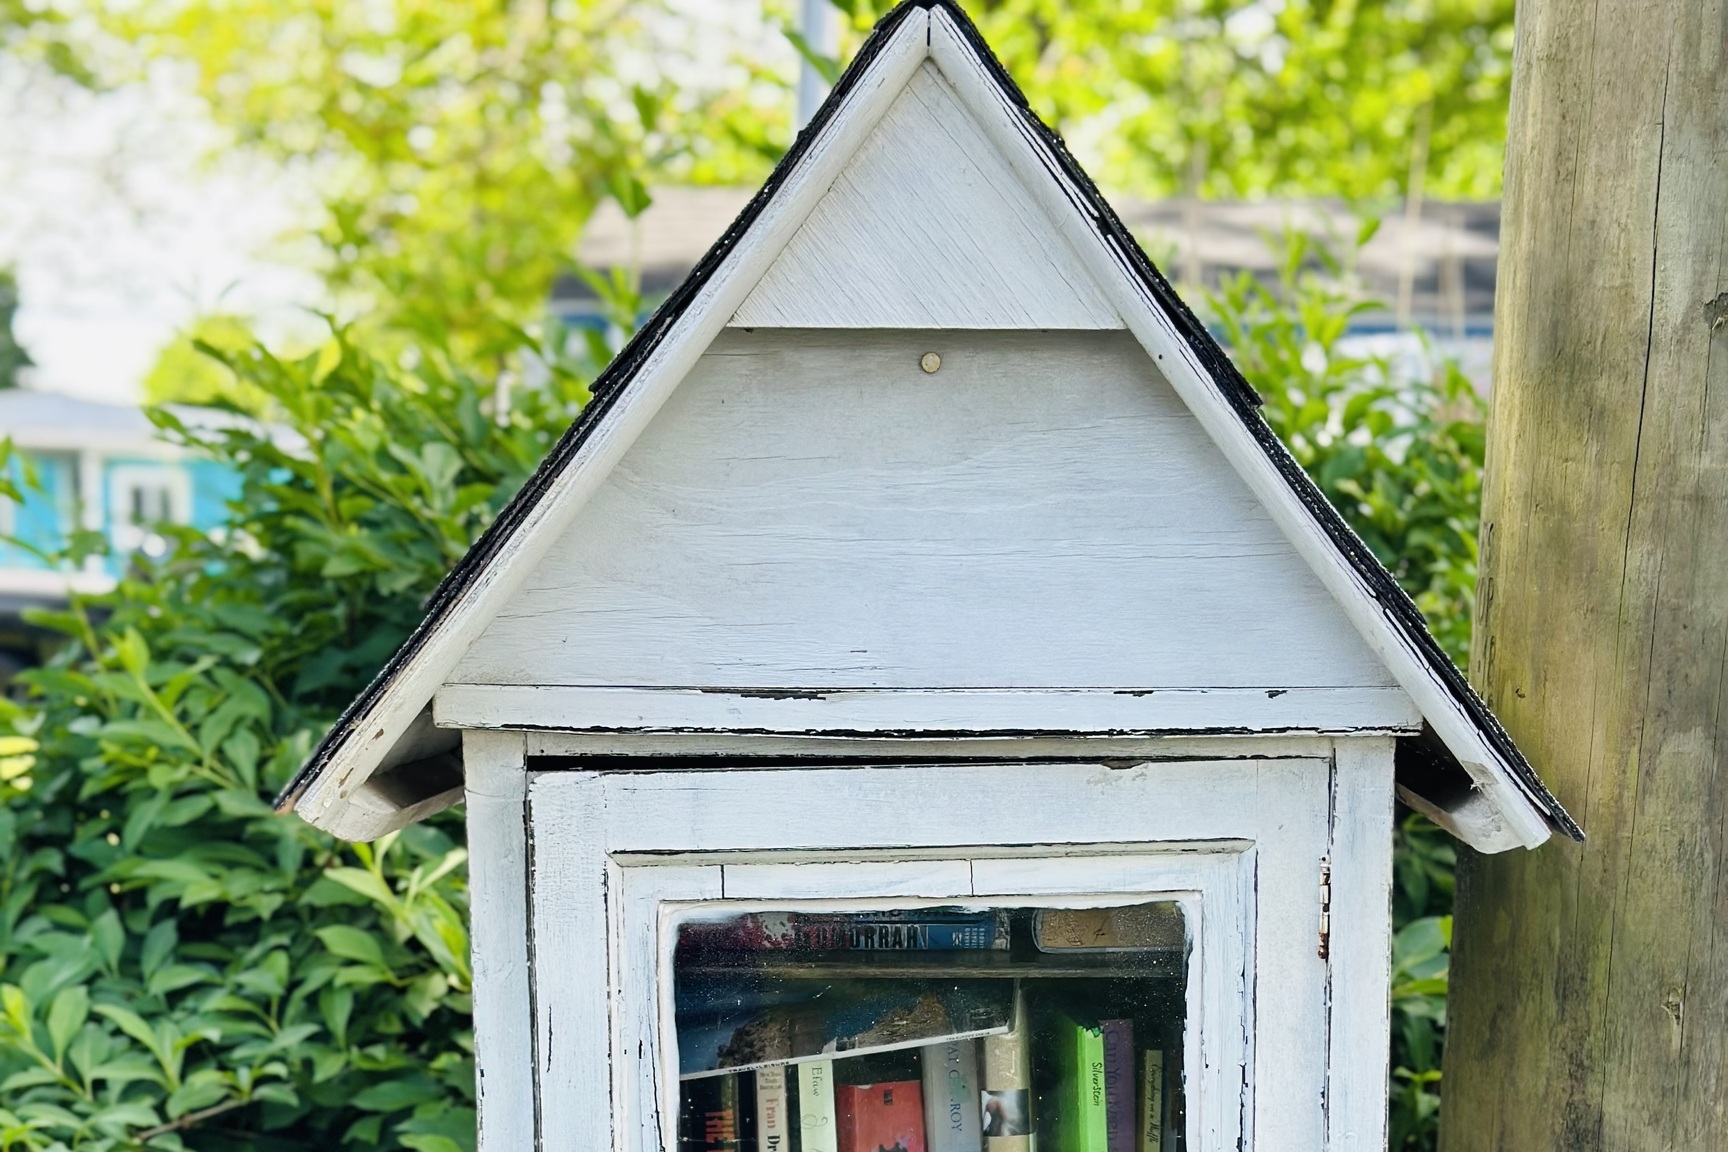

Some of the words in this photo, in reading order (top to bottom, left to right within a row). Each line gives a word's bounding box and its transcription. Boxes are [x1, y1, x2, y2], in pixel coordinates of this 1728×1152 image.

[812, 1066, 823, 1098] Efaw
[1091, 1062, 1103, 1107] Silverstein
[704, 1108, 735, 1144] THE
[765, 1098, 780, 1129] Fran
